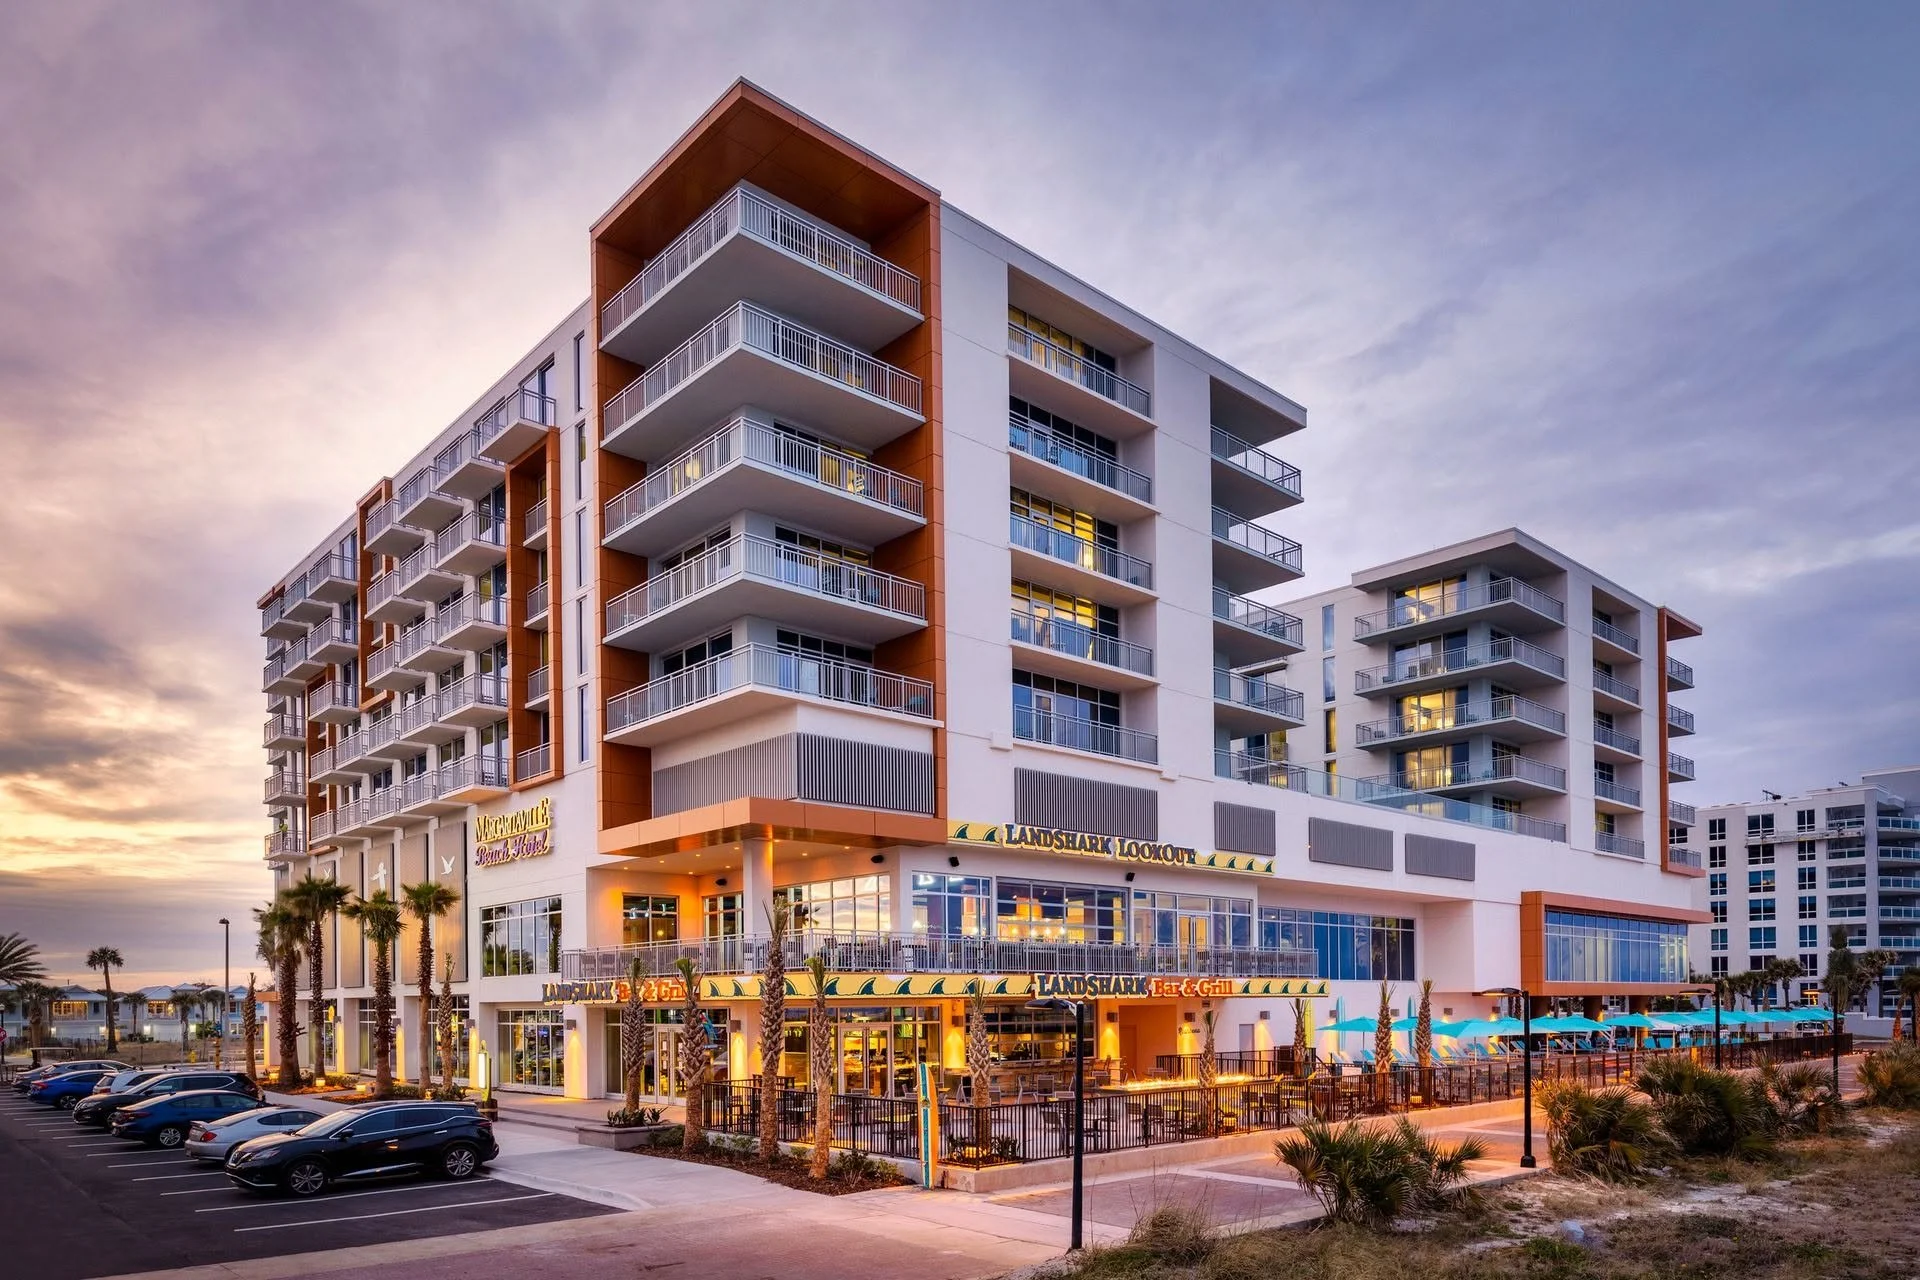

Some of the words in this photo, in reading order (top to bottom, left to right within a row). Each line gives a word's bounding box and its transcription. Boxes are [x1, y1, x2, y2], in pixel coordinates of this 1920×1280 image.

[475, 839, 511, 867] Beach
[512, 829, 550, 859] Hotel
[1004, 823, 1112, 855] LANDSHARK
[1037, 974, 1148, 997] LANDSHARK
[1153, 979, 1179, 995] Bar
[1183, 979, 1196, 995] &
[1199, 980, 1233, 995] Grill
